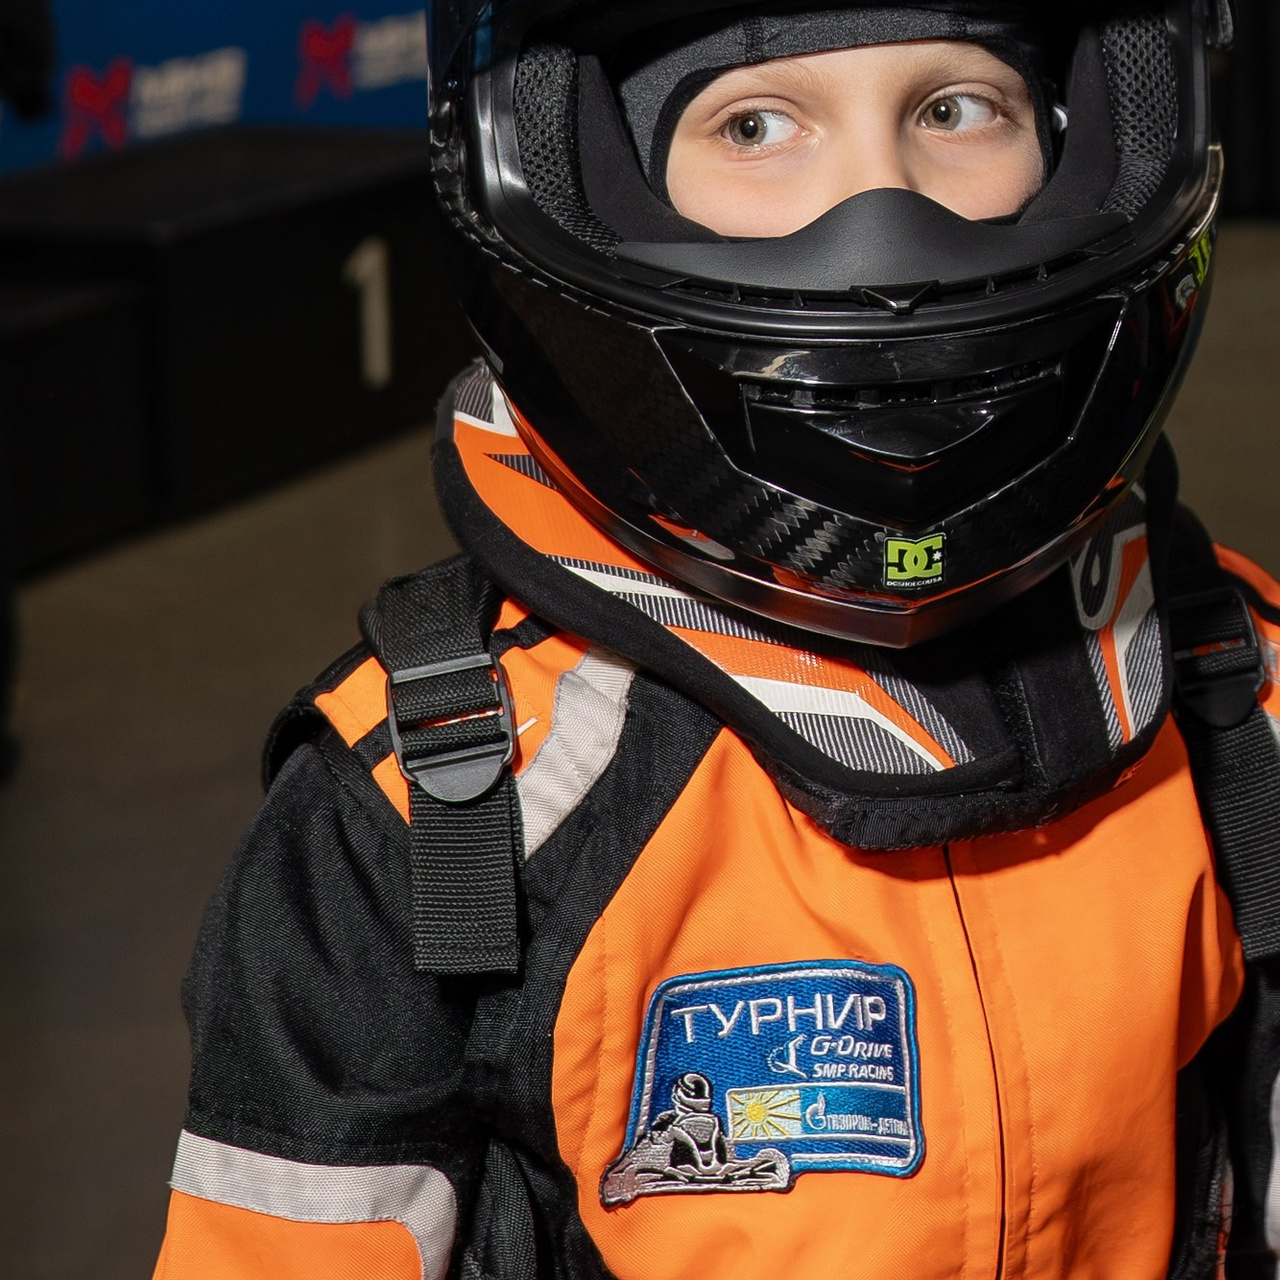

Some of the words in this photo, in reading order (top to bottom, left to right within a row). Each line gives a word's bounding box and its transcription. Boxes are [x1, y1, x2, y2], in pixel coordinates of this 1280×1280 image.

[345, 237, 393, 389] 1
[887, 536, 943, 580] DC
[671, 992, 887, 1044] ТУРНИР
[812, 1063, 846, 1079] SMP
